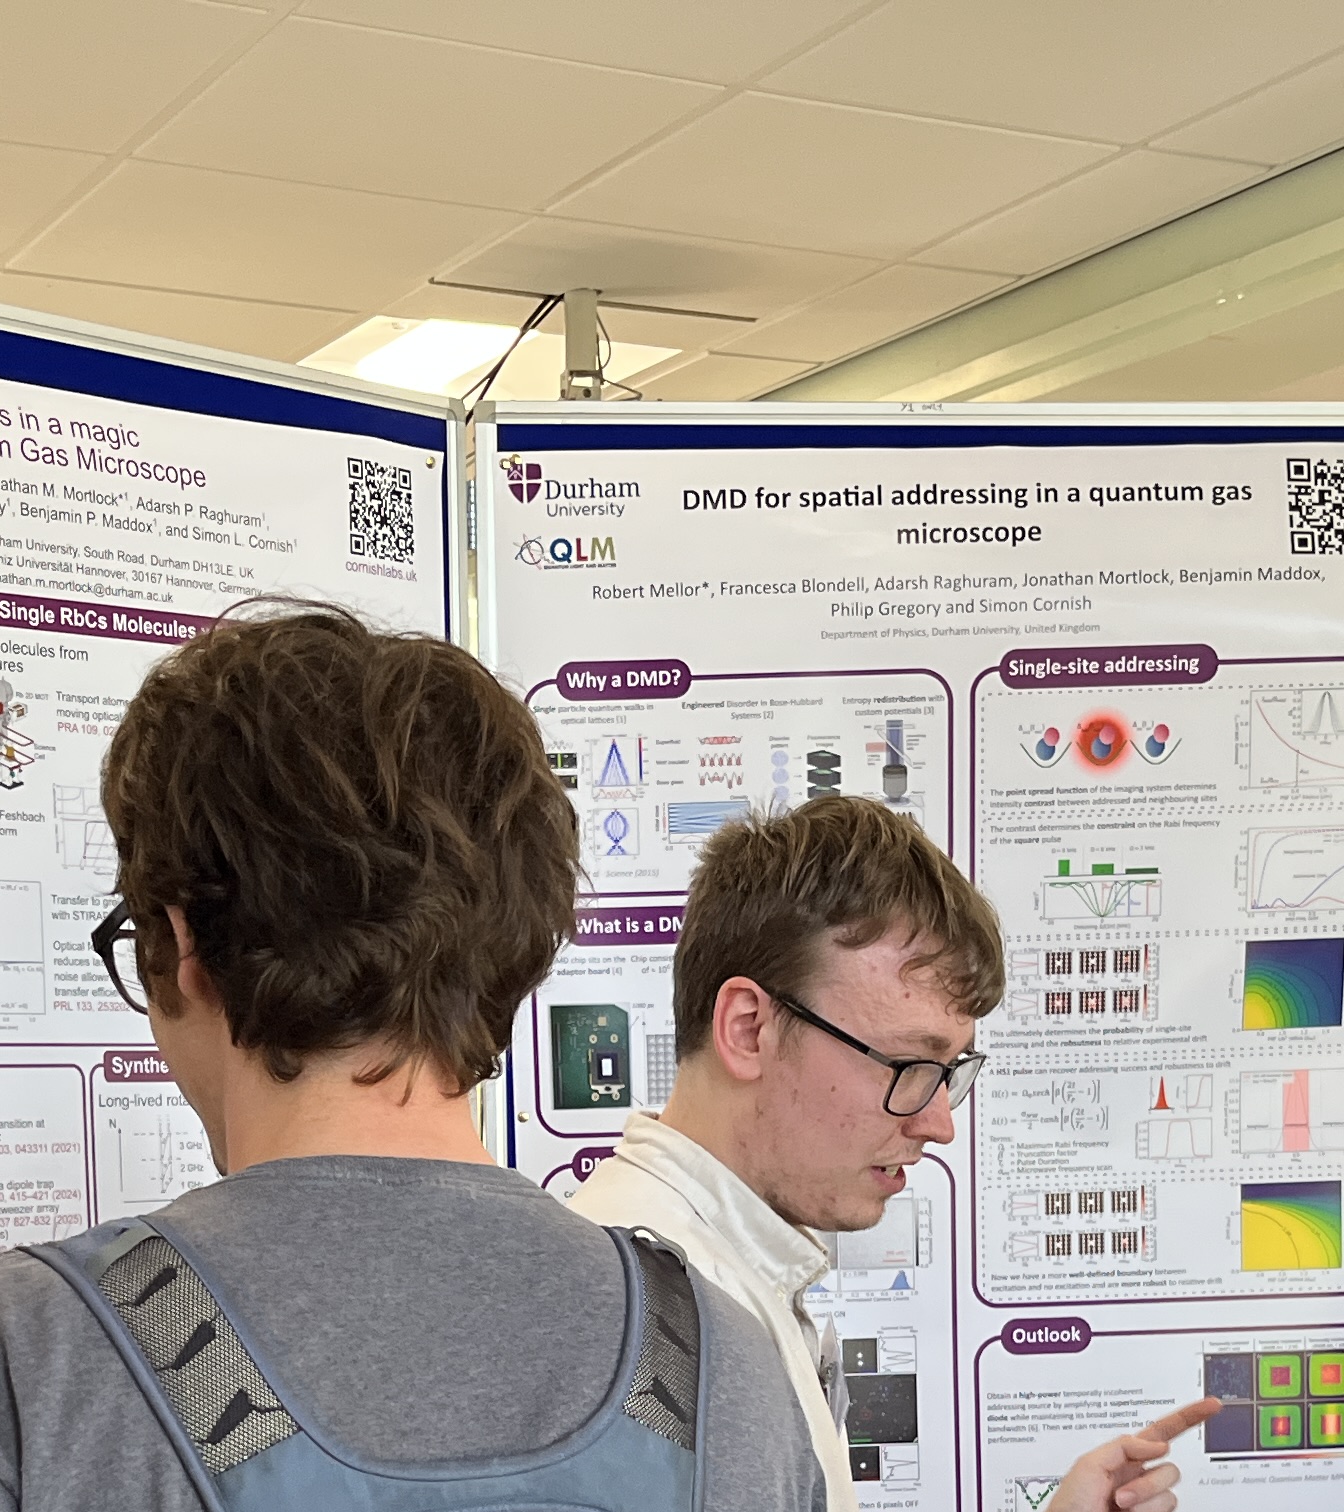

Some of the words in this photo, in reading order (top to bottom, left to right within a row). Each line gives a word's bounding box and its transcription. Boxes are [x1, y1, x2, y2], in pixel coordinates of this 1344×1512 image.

[17, 406, 40, 431] in
[47, 417, 62, 435] a
[69, 421, 139, 450] magic
[20, 437, 68, 466] Gas
[76, 445, 205, 490] Microscope
[544, 477, 640, 499] Durham
[683, 488, 746, 510] DMD
[754, 486, 791, 508] for
[799, 484, 881, 512] spatial
[891, 482, 1027, 508] addressing
[1035, 482, 1057, 502] in
[1067, 487, 1080, 502] a
[1089, 483, 1203, 506] quantum
[1211, 485, 1252, 505] gas
[546, 502, 624, 517] University
[897, 522, 1041, 547] microscope
[549, 536, 615, 563] QLM
[346, 561, 417, 582] cornishlabs.uk
[831, 601, 873, 619] Philip
[878, 601, 941, 618] Gregory
[945, 598, 974, 614] and
[979, 599, 1027, 612] Simon
[1033, 595, 1091, 611] Cornish
[60, 606, 107, 629] RbCs
[112, 612, 196, 639] Molecules
[59, 645, 88, 661] from
[1008, 657, 1099, 678] Single-site
[1104, 654, 1199, 674] addressing
[565, 670, 606, 691] Why
[611, 674, 621, 687] a
[626, 668, 680, 686] DMD?
[575, 917, 621, 934] What
[625, 916, 639, 932] is
[658, 916, 685, 932] DM
[1012, 1325, 1080, 1343] Outlook
